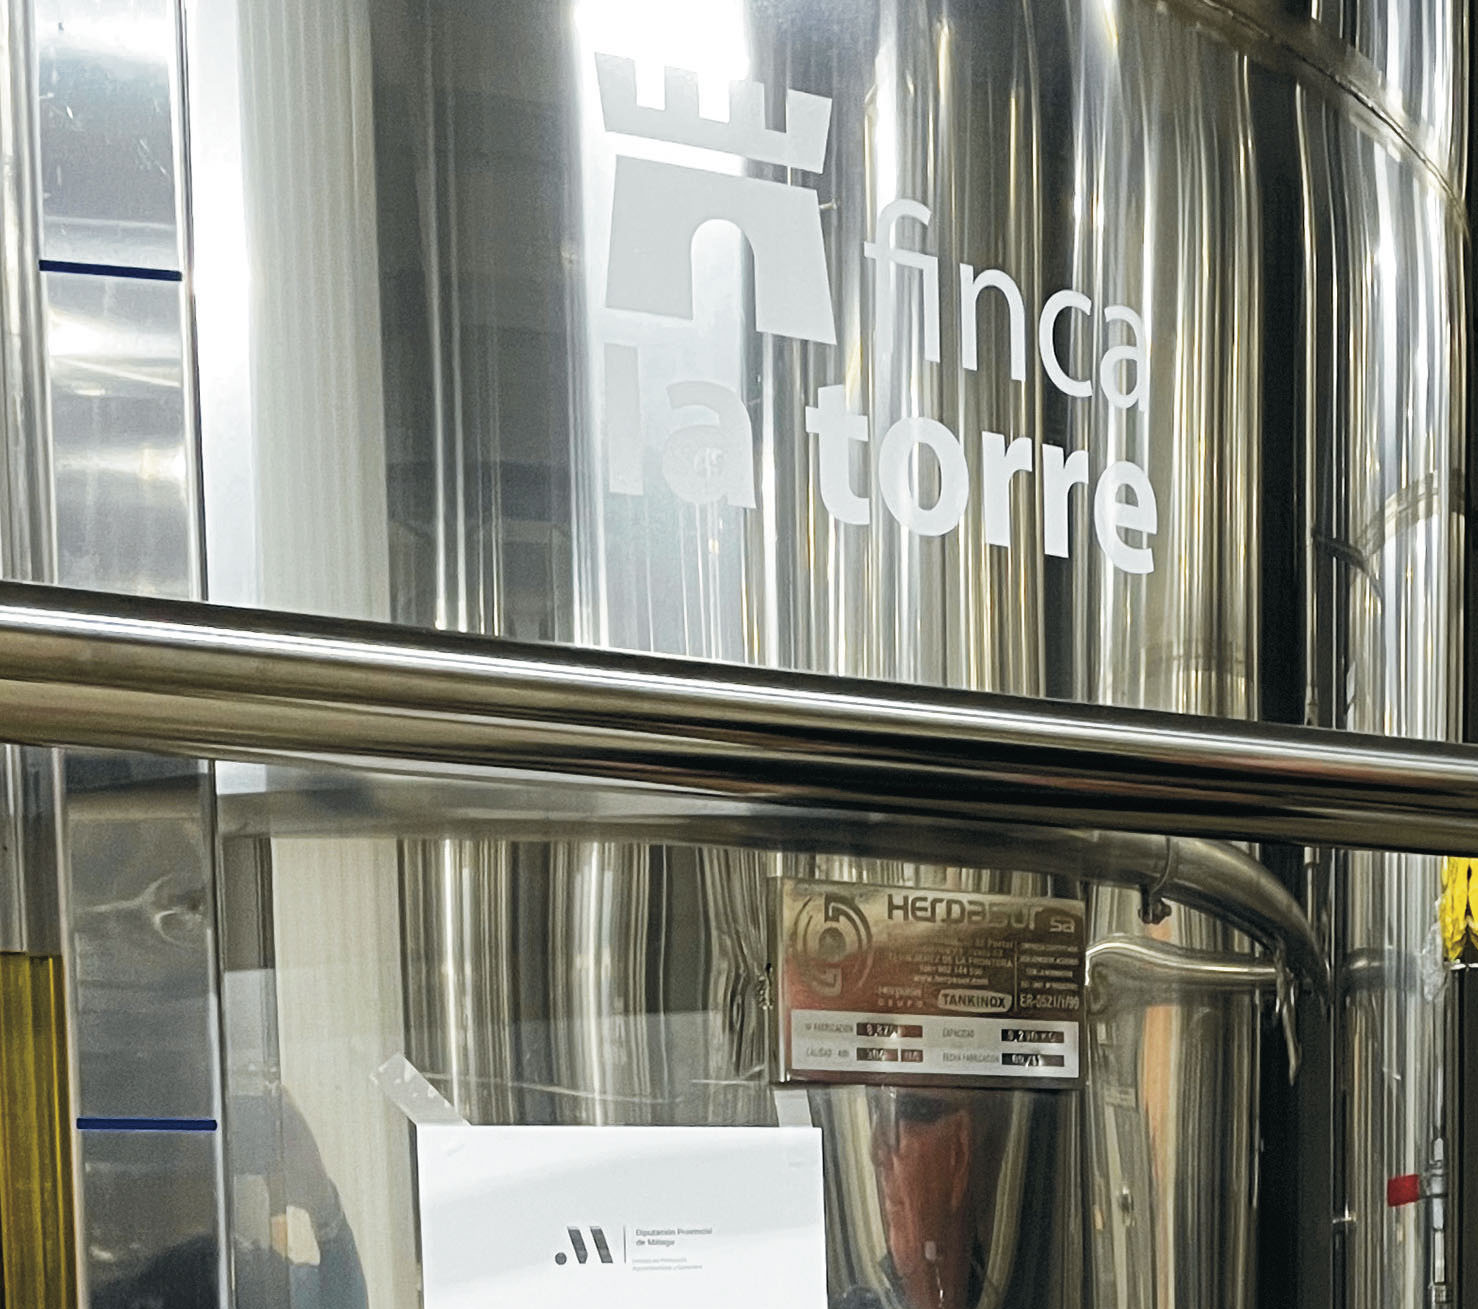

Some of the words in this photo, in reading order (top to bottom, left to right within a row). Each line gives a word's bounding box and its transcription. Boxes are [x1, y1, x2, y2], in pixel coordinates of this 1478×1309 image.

[864, 198, 1150, 411] finca
[604, 341, 756, 509] la
[805, 384, 1158, 574] torre
[942, 994, 1005, 1008] TANKINOX
